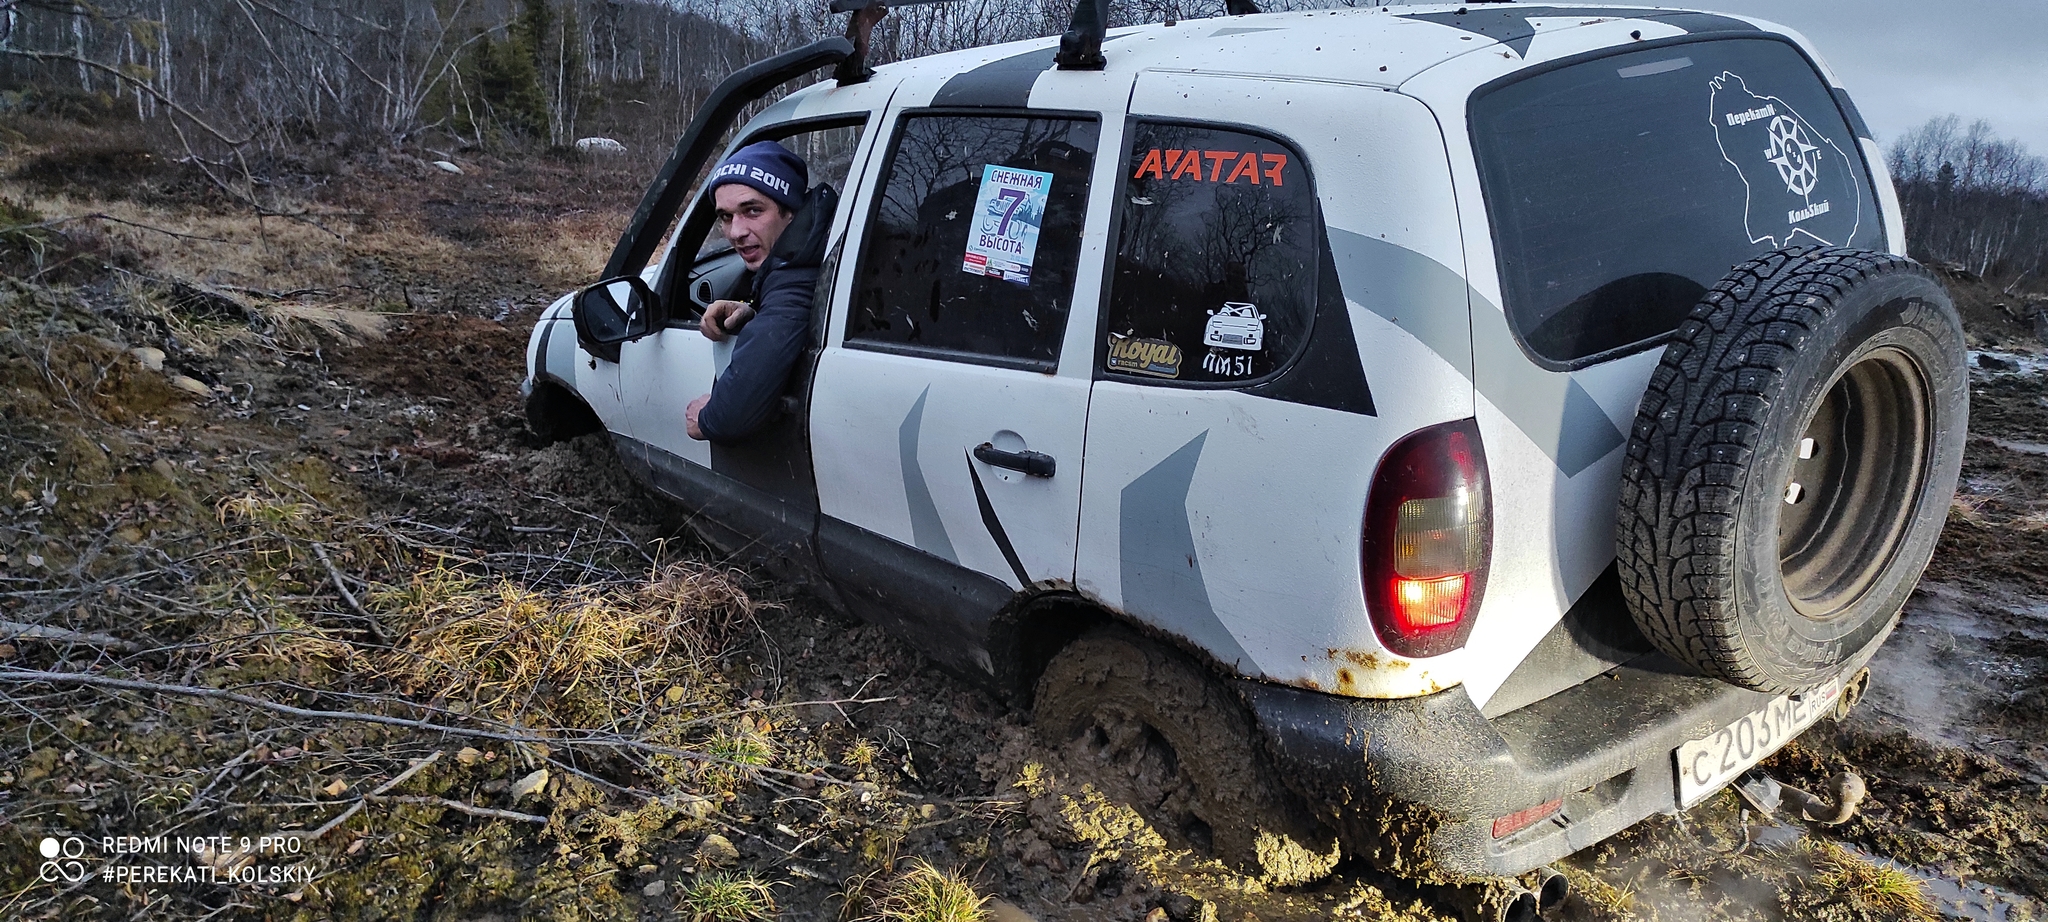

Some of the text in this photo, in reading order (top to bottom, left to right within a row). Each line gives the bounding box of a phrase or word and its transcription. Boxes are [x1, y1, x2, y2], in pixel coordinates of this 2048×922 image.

[712, 163, 790, 196] OCHI 2014
[991, 169, 1043, 189] СНЕЖНАЯ
[1133, 149, 1288, 187] AVATAR
[998, 187, 1026, 236] 7
[979, 234, 1023, 255] ВЫСОТА
[1112, 338, 1177, 368] Royal
[1810, 690, 1827, 711] RUS
